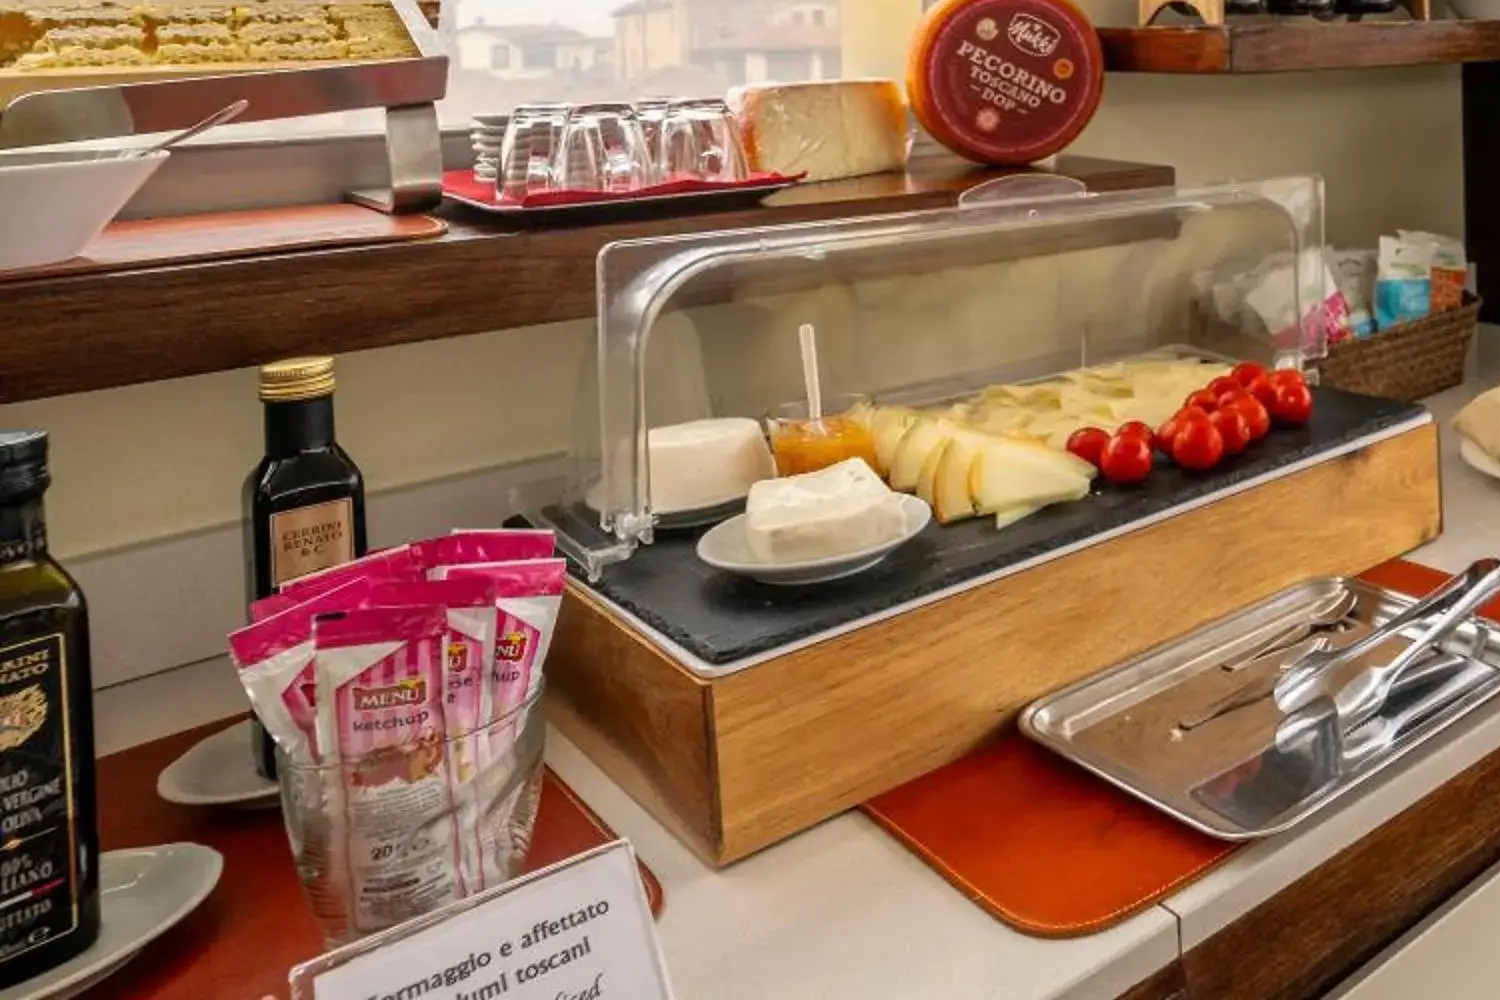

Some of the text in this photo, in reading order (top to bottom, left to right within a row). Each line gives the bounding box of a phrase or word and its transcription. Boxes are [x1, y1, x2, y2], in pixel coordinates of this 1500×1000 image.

[956, 40, 1067, 104] PECORINO
[970, 64, 1041, 108] TOSCANO
[981, 87, 1017, 111] DOP
[359, 687, 419, 707] MENU
[353, 710, 430, 732] ketchup
[499, 941, 513, 958] e
[521, 900, 609, 949] affettato
[515, 935, 591, 984] toscani
